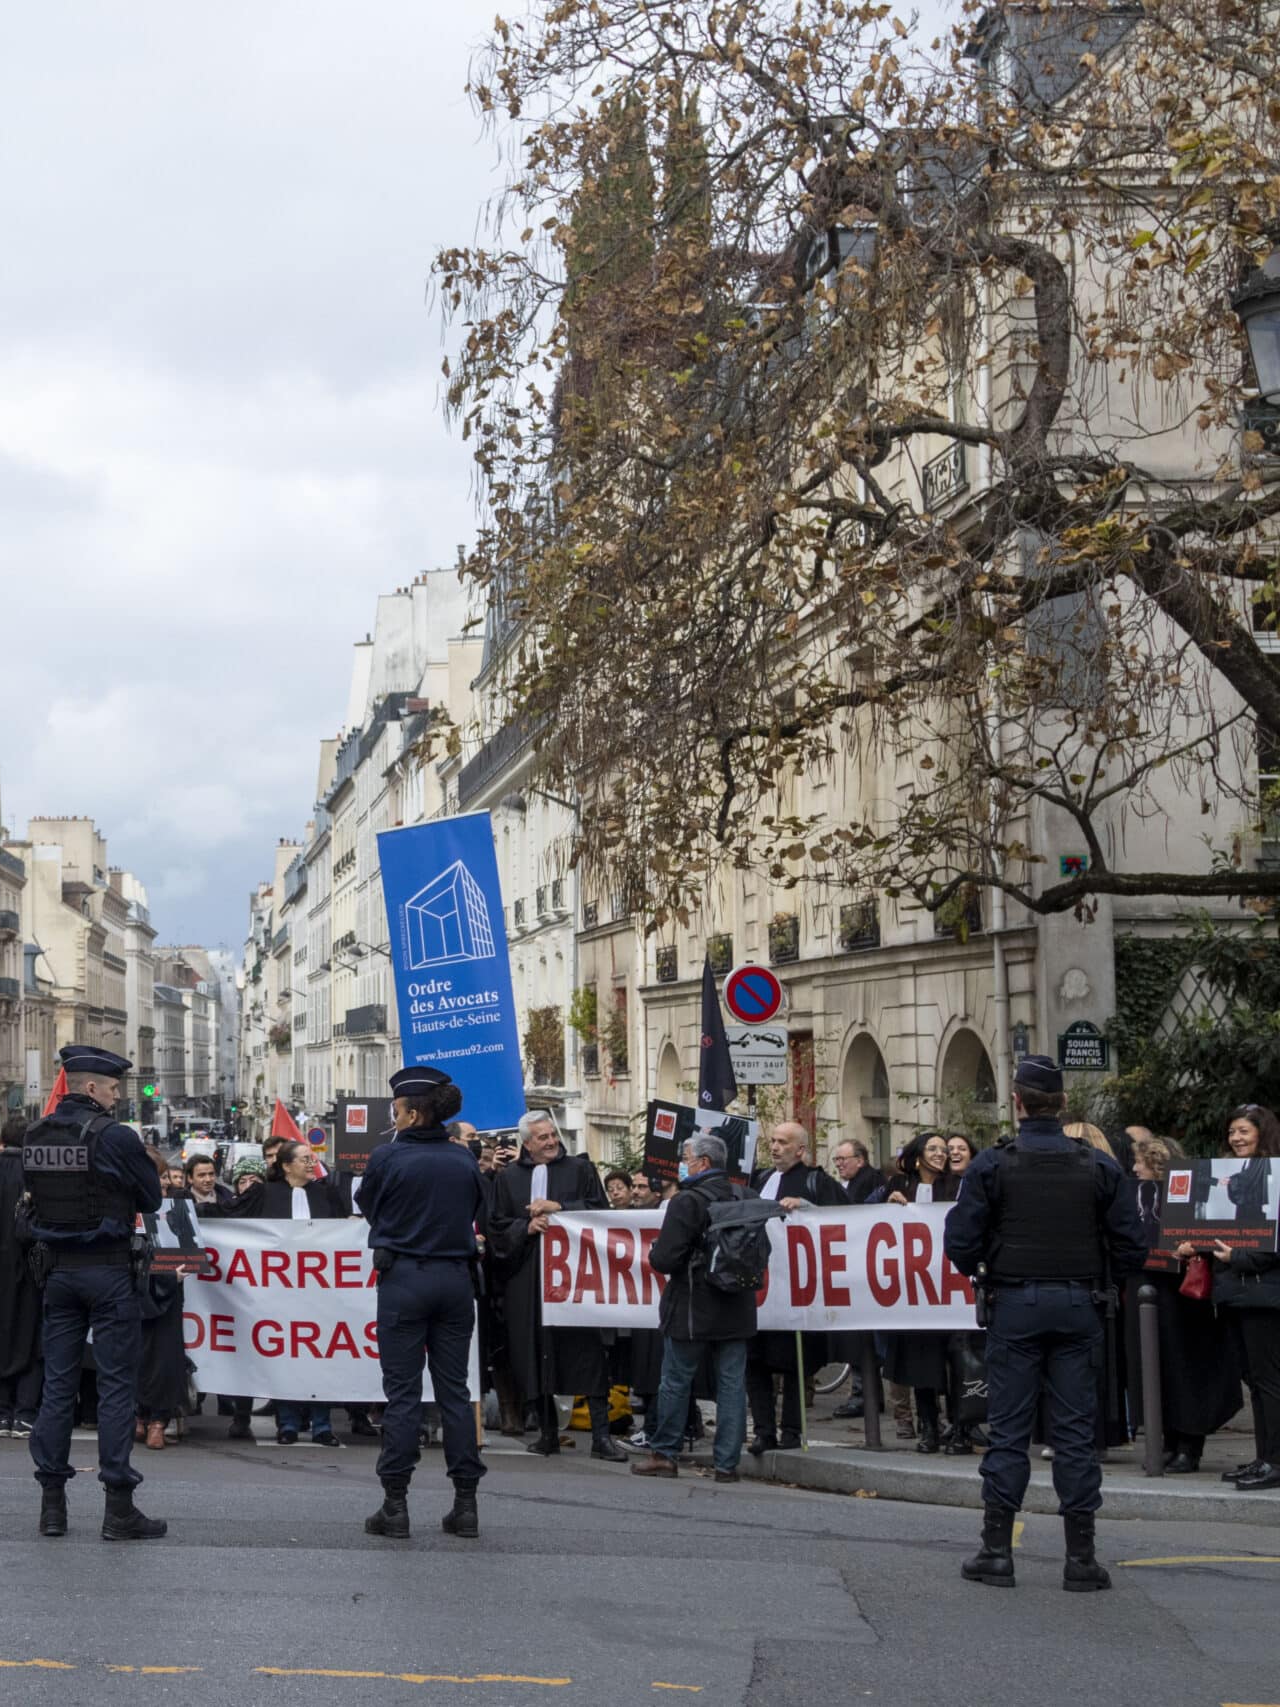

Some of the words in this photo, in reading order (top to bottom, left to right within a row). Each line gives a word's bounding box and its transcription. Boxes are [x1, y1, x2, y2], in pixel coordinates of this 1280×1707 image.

[408, 980, 452, 997] Ordre
[410, 1000, 434, 1014] des
[438, 990, 499, 1010] Avocats
[412, 1011, 501, 1034] Hauts-de-Seine
[415, 1043, 504, 1062] www.barreau92.com
[1066, 1048, 1101, 1056] FRANCIS
[1067, 1040, 1100, 1048] SQUARE
[24, 1148, 86, 1165] POLICE
[197, 1246, 378, 1289] BARRE
[786, 1224, 850, 1307] DE
[866, 1221, 977, 1308] GRA
[182, 1312, 236, 1353] DE
